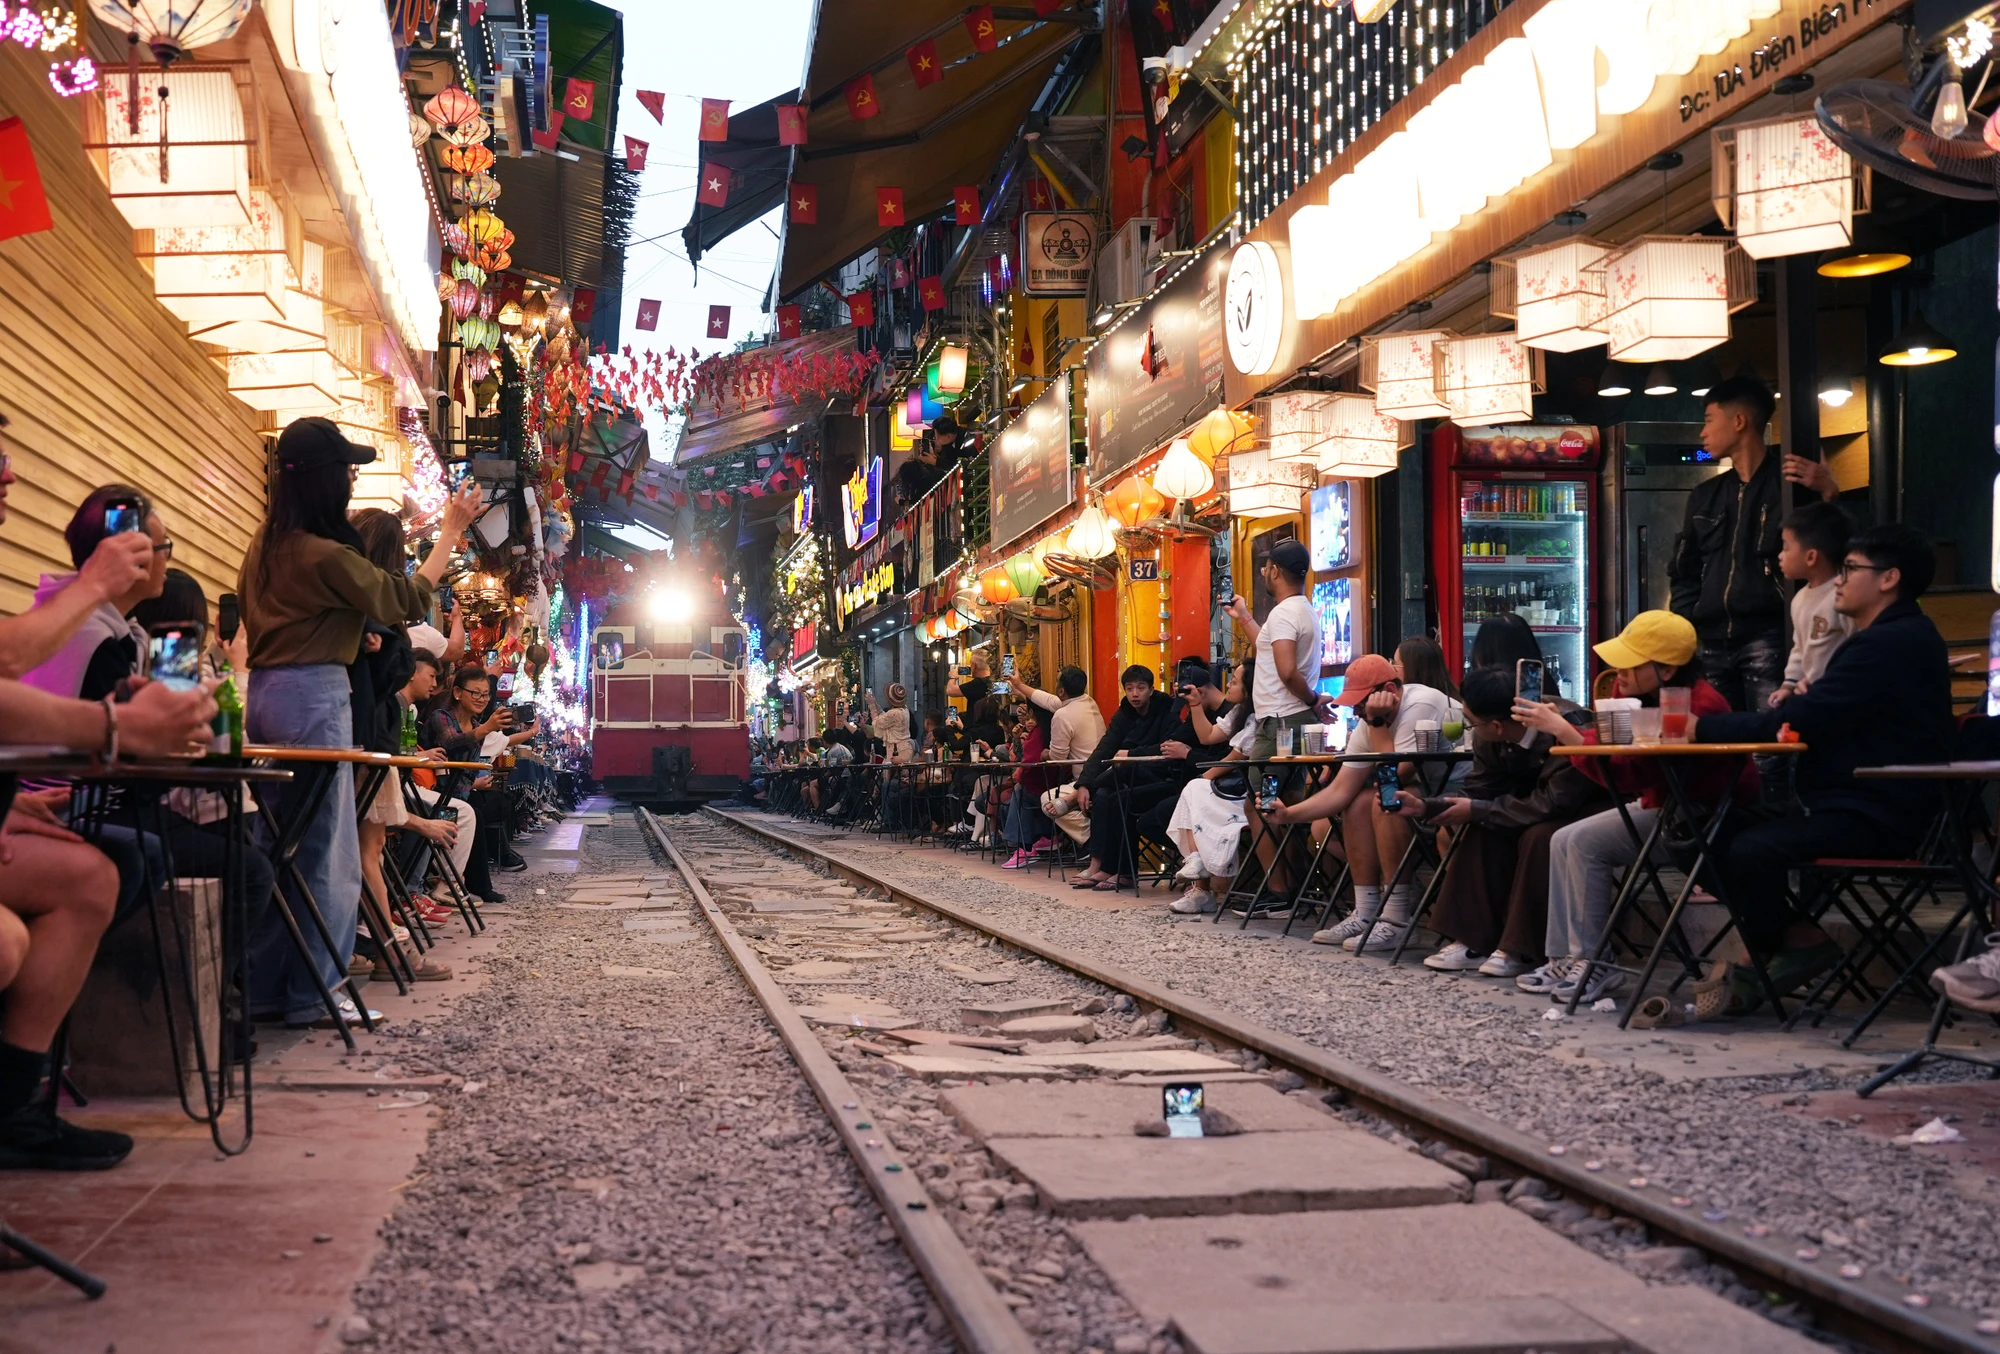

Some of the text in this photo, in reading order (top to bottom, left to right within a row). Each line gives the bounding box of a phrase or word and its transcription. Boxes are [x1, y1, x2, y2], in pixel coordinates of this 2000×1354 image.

[1750, 35, 1795, 80] Điện
[1800, 2, 1847, 49] Biên
[1032, 269, 1043, 280] GA
[1134, 562, 1153, 578] 37
[1811, 615, 1829, 640] P
